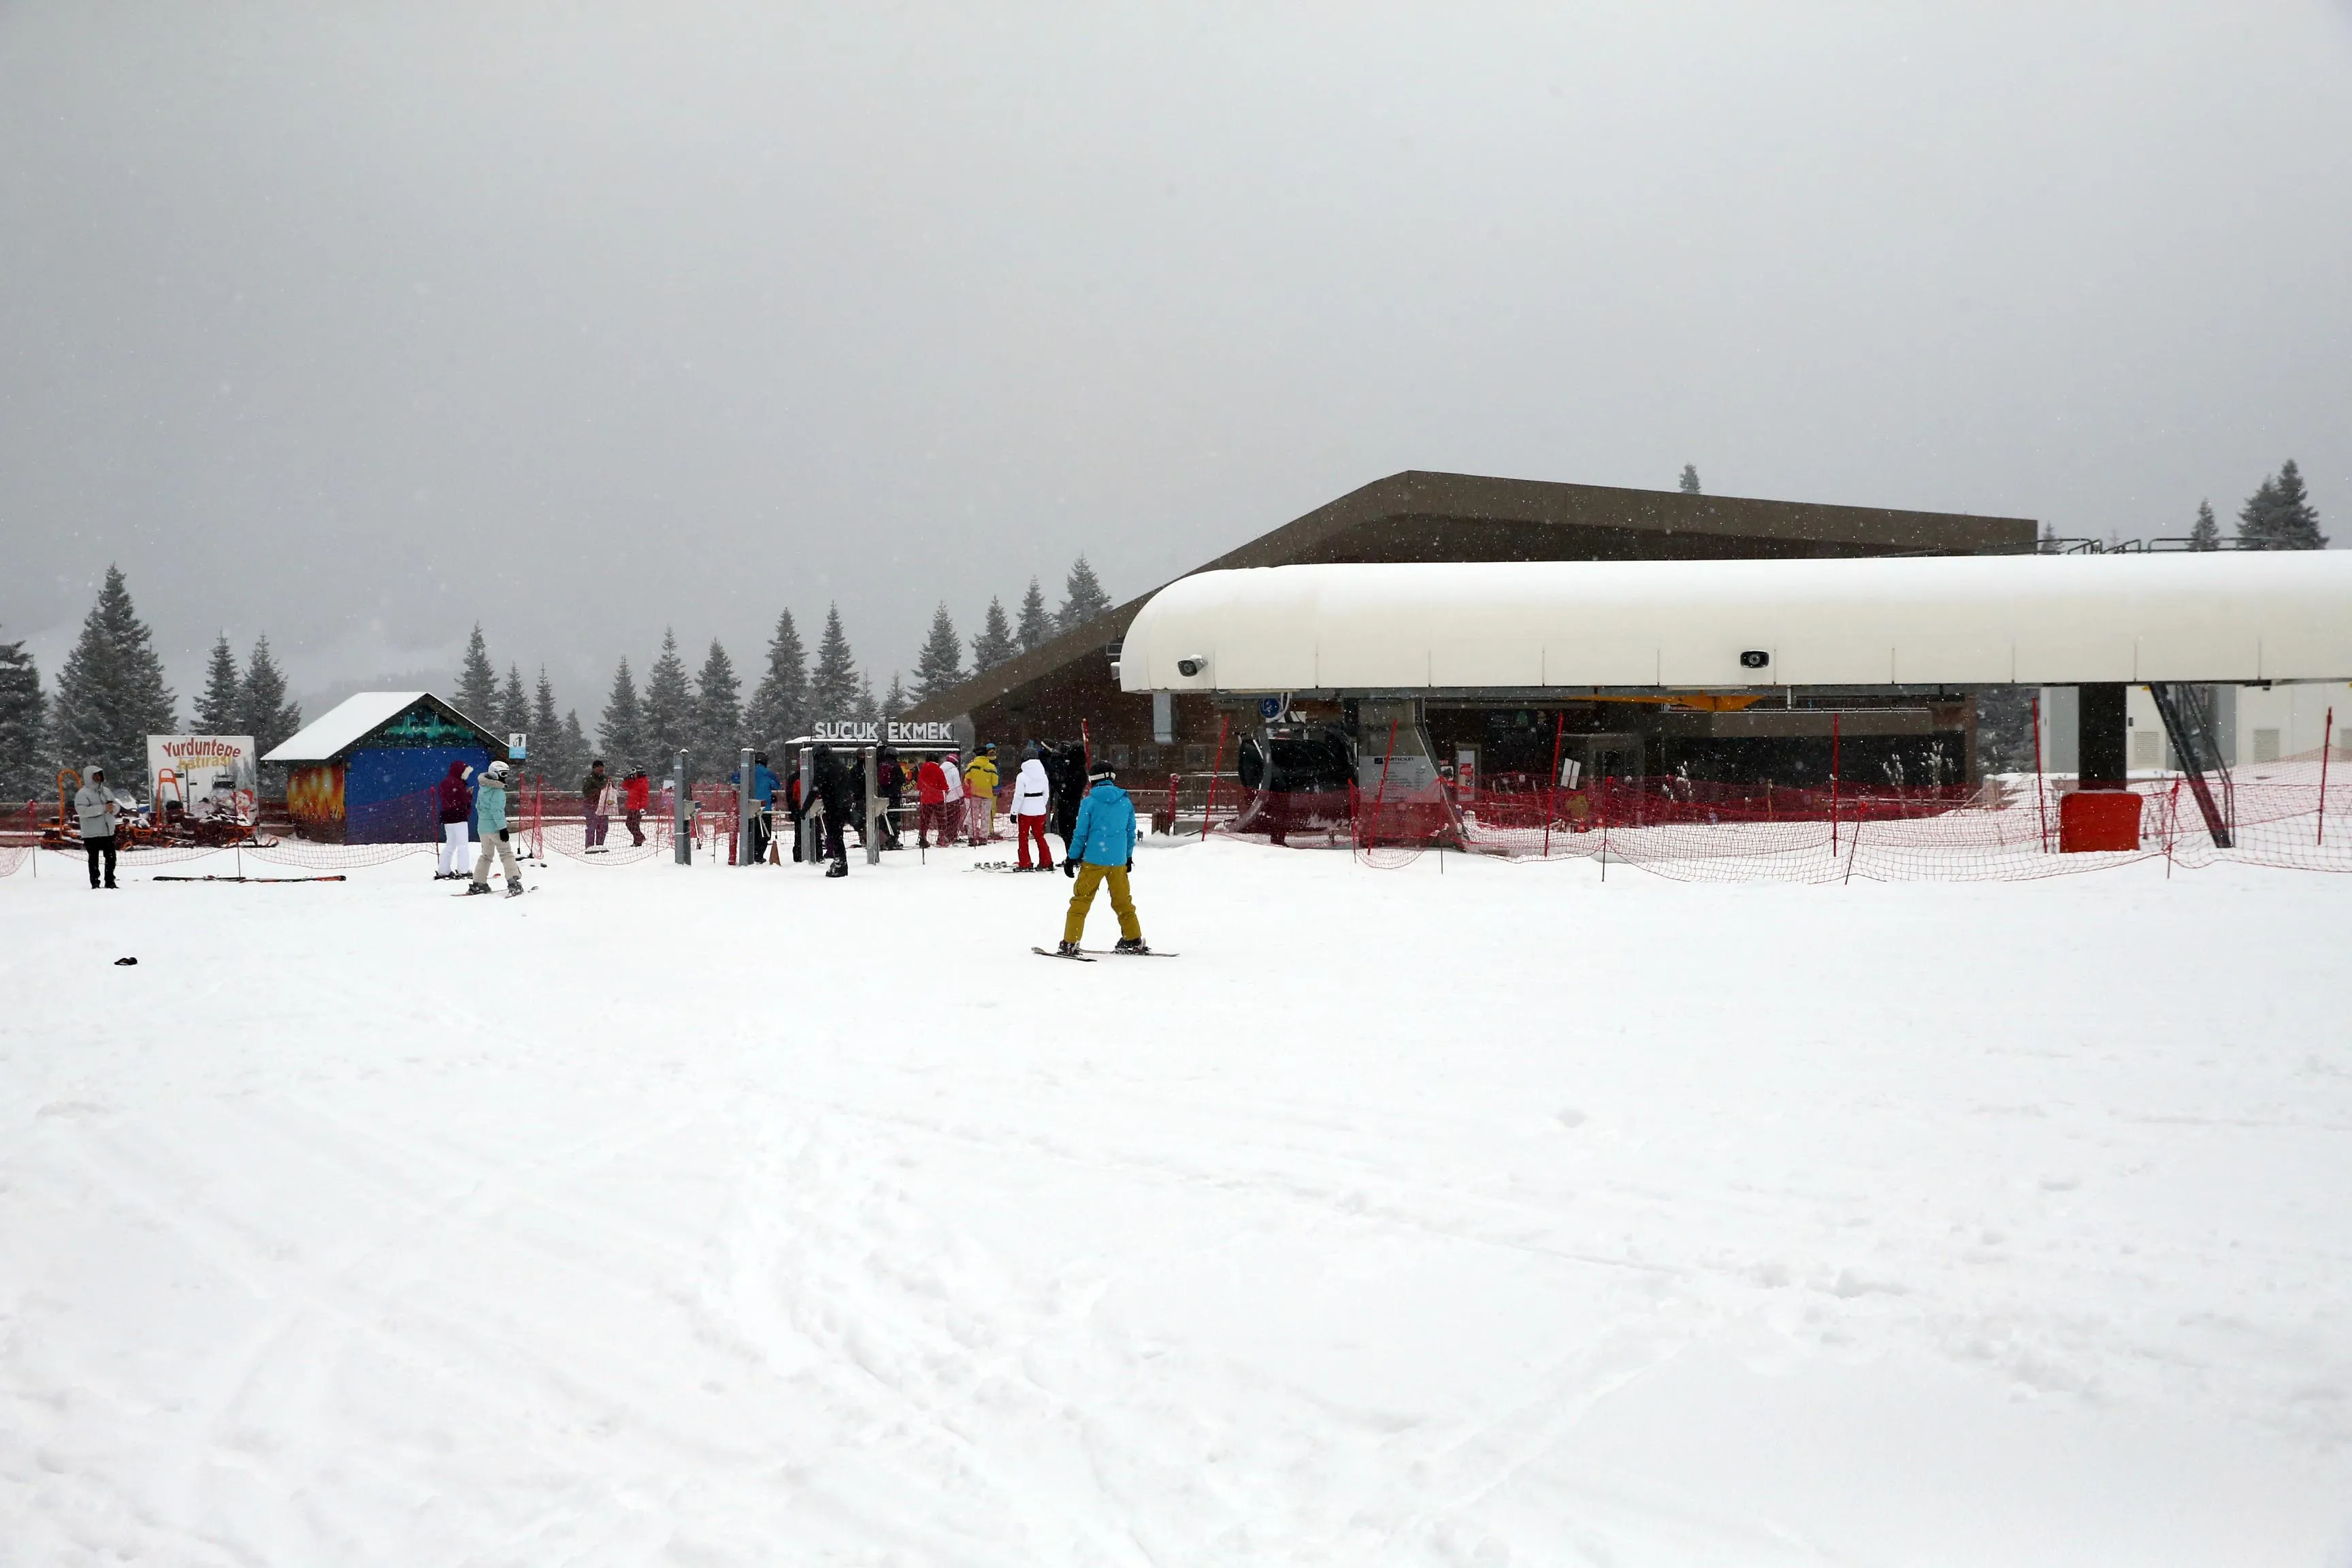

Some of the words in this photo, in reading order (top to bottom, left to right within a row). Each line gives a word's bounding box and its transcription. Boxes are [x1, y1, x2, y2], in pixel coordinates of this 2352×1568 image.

[815, 722, 879, 739] SUCUK
[887, 722, 951, 739] EKMEK
[162, 737, 241, 757] Yurduntepe
